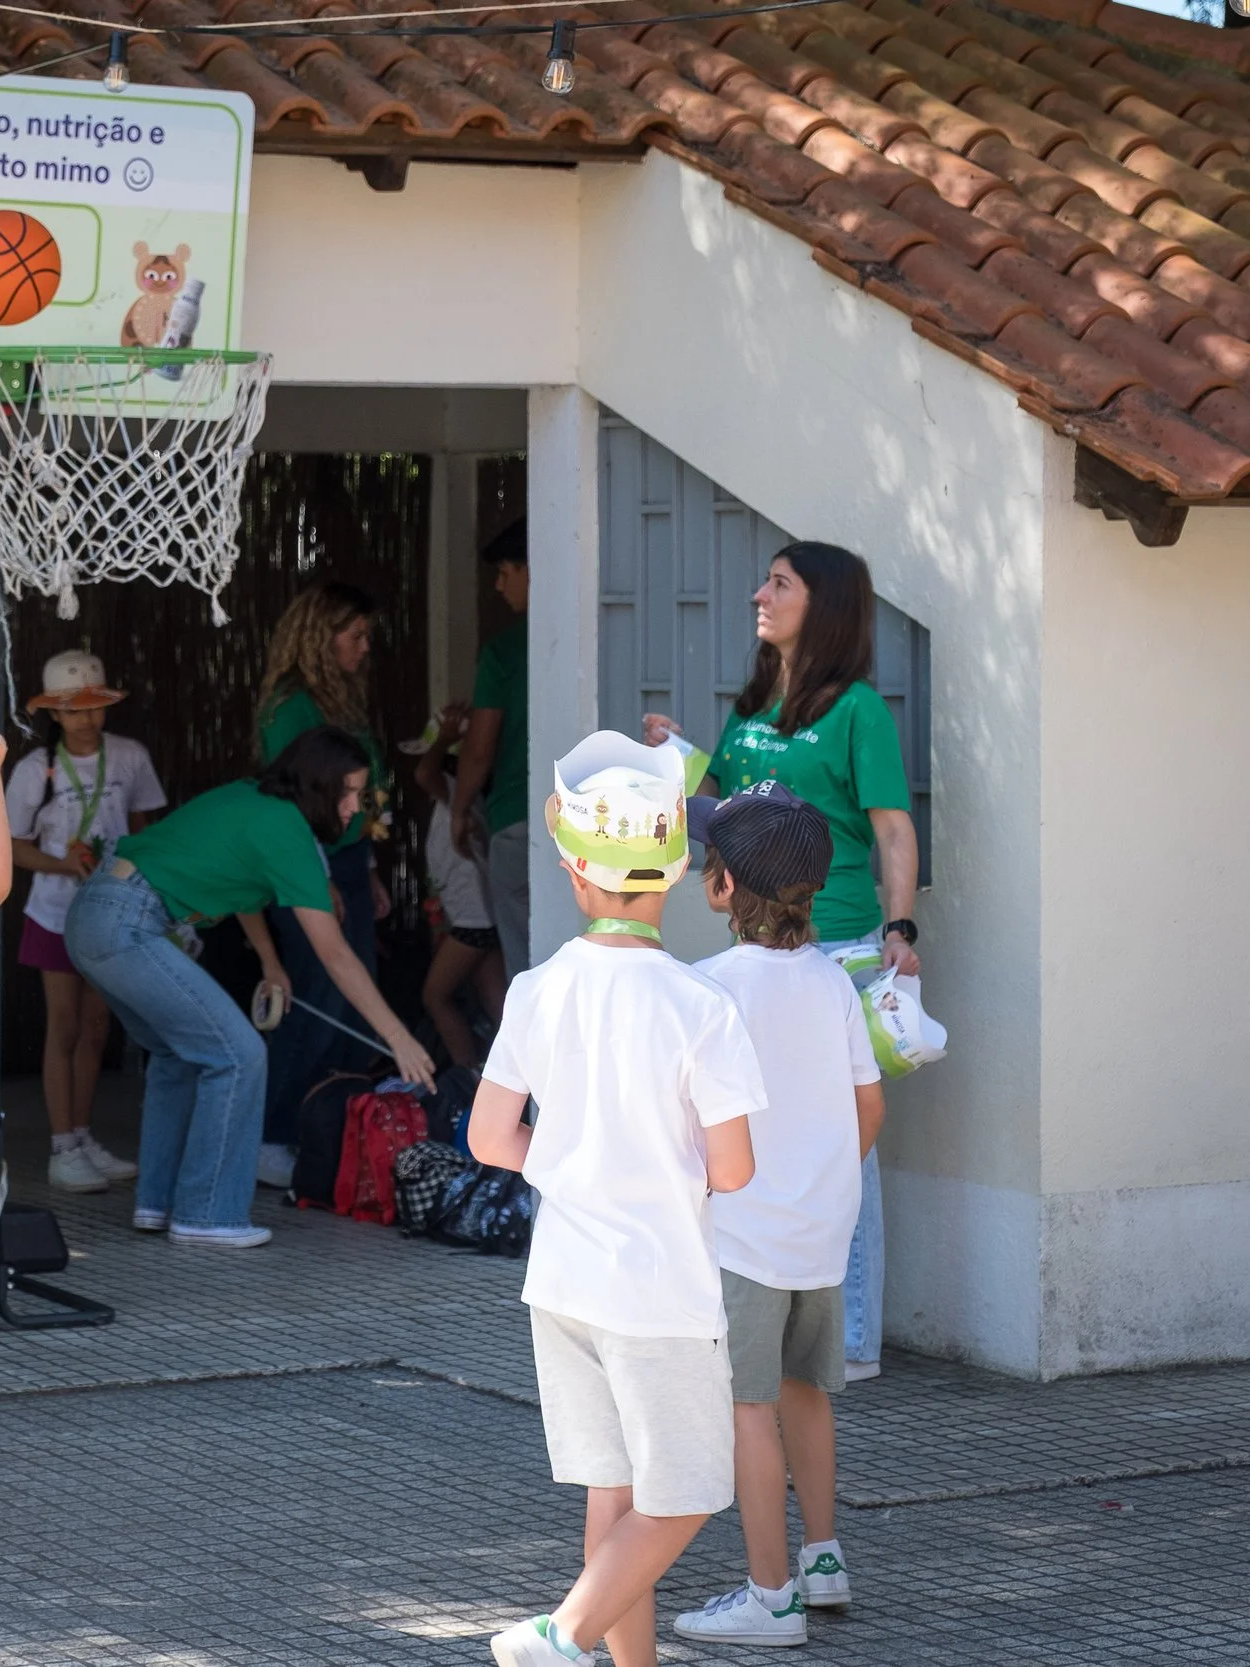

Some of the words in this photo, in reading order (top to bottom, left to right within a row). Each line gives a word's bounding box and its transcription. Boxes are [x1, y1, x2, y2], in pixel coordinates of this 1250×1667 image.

[27, 113, 141, 147] nutrição
[150, 125, 165, 145] e
[35, 160, 110, 184] mimo
